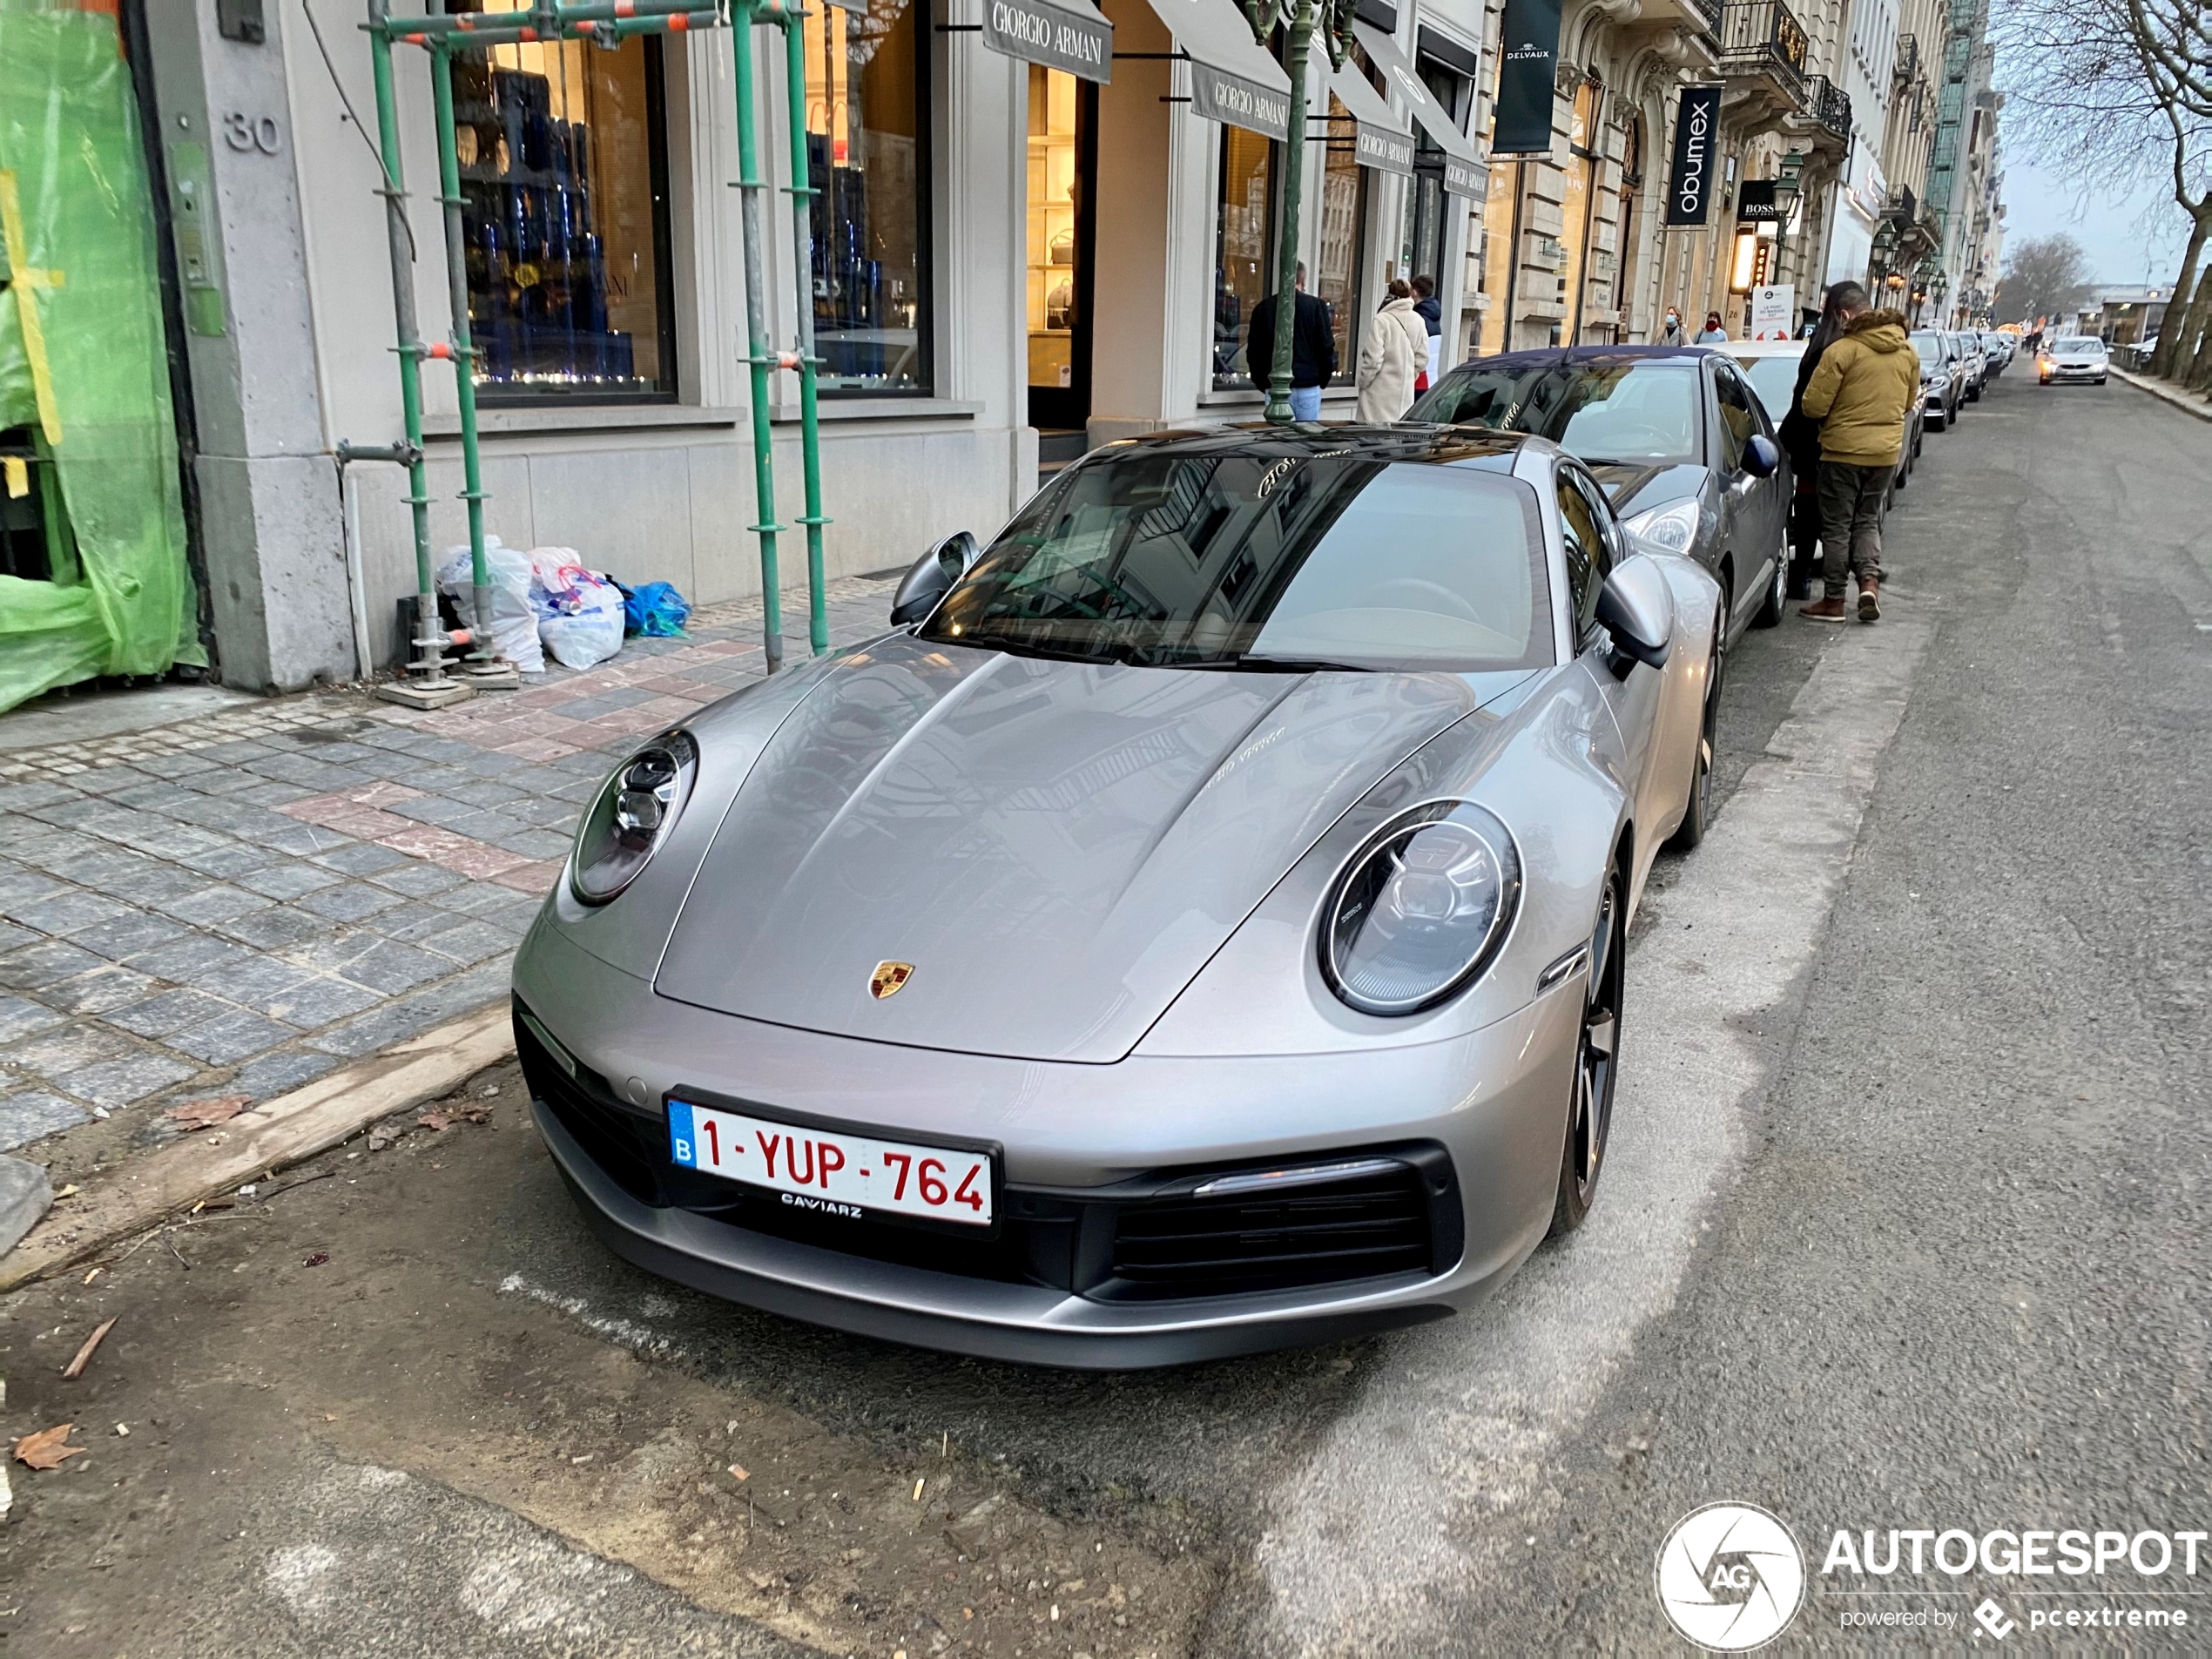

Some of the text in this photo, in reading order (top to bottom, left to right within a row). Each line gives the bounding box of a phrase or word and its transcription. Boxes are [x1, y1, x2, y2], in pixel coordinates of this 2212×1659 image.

[993, 1, 1102, 64] GIORGIO ARMANI
[1507, 51, 1549, 60] DELVAUX
[1215, 82, 1285, 126] GIORGIO ARMANI
[223, 113, 280, 156] 30
[1360, 132, 1411, 165] GIORGIO ARMANI
[1679, 101, 1710, 212] obumex
[1447, 164, 1487, 192] GIORGIO ARMANI
[1745, 204, 1775, 213] BOSS
[1729, 310, 1738, 319] 26
[1804, 327, 1813, 338] P
[675, 1138, 692, 1161] B
[781, 1192, 863, 1218] CAVIARZ
